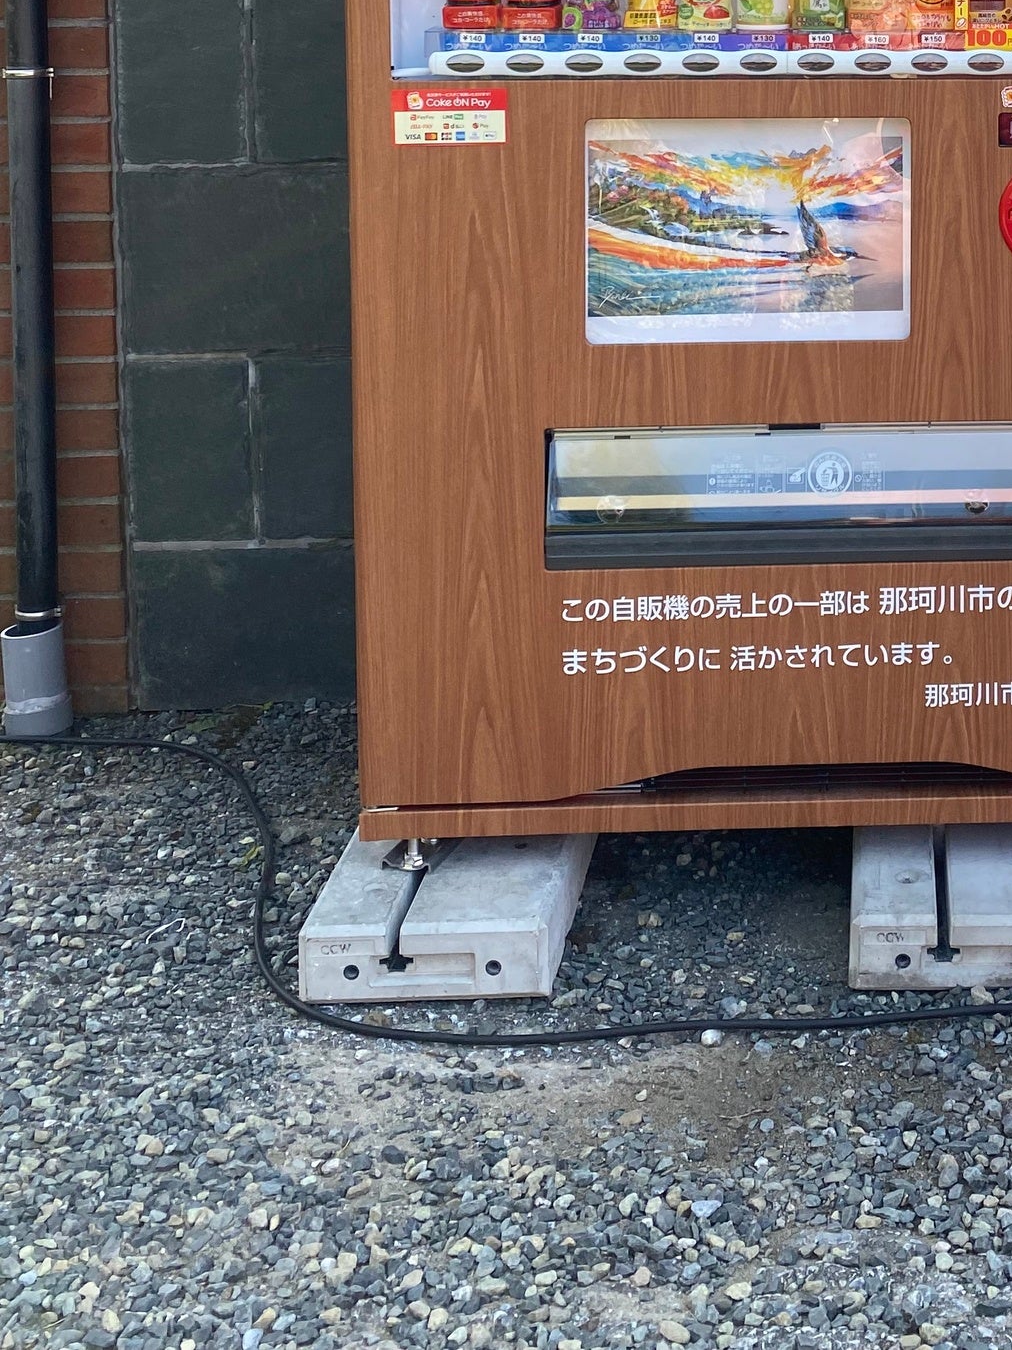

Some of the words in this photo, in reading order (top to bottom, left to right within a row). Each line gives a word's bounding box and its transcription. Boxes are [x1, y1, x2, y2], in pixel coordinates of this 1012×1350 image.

[426, 98, 452, 107] Coke
[453, 97, 470, 107] ON
[470, 98, 491, 109] Pay
[561, 590, 870, 623] この自販機の売上の一部は
[562, 646, 721, 676] まちづくりに
[729, 641, 953, 672] 活かされています。
[320, 943, 352, 956] CCW
